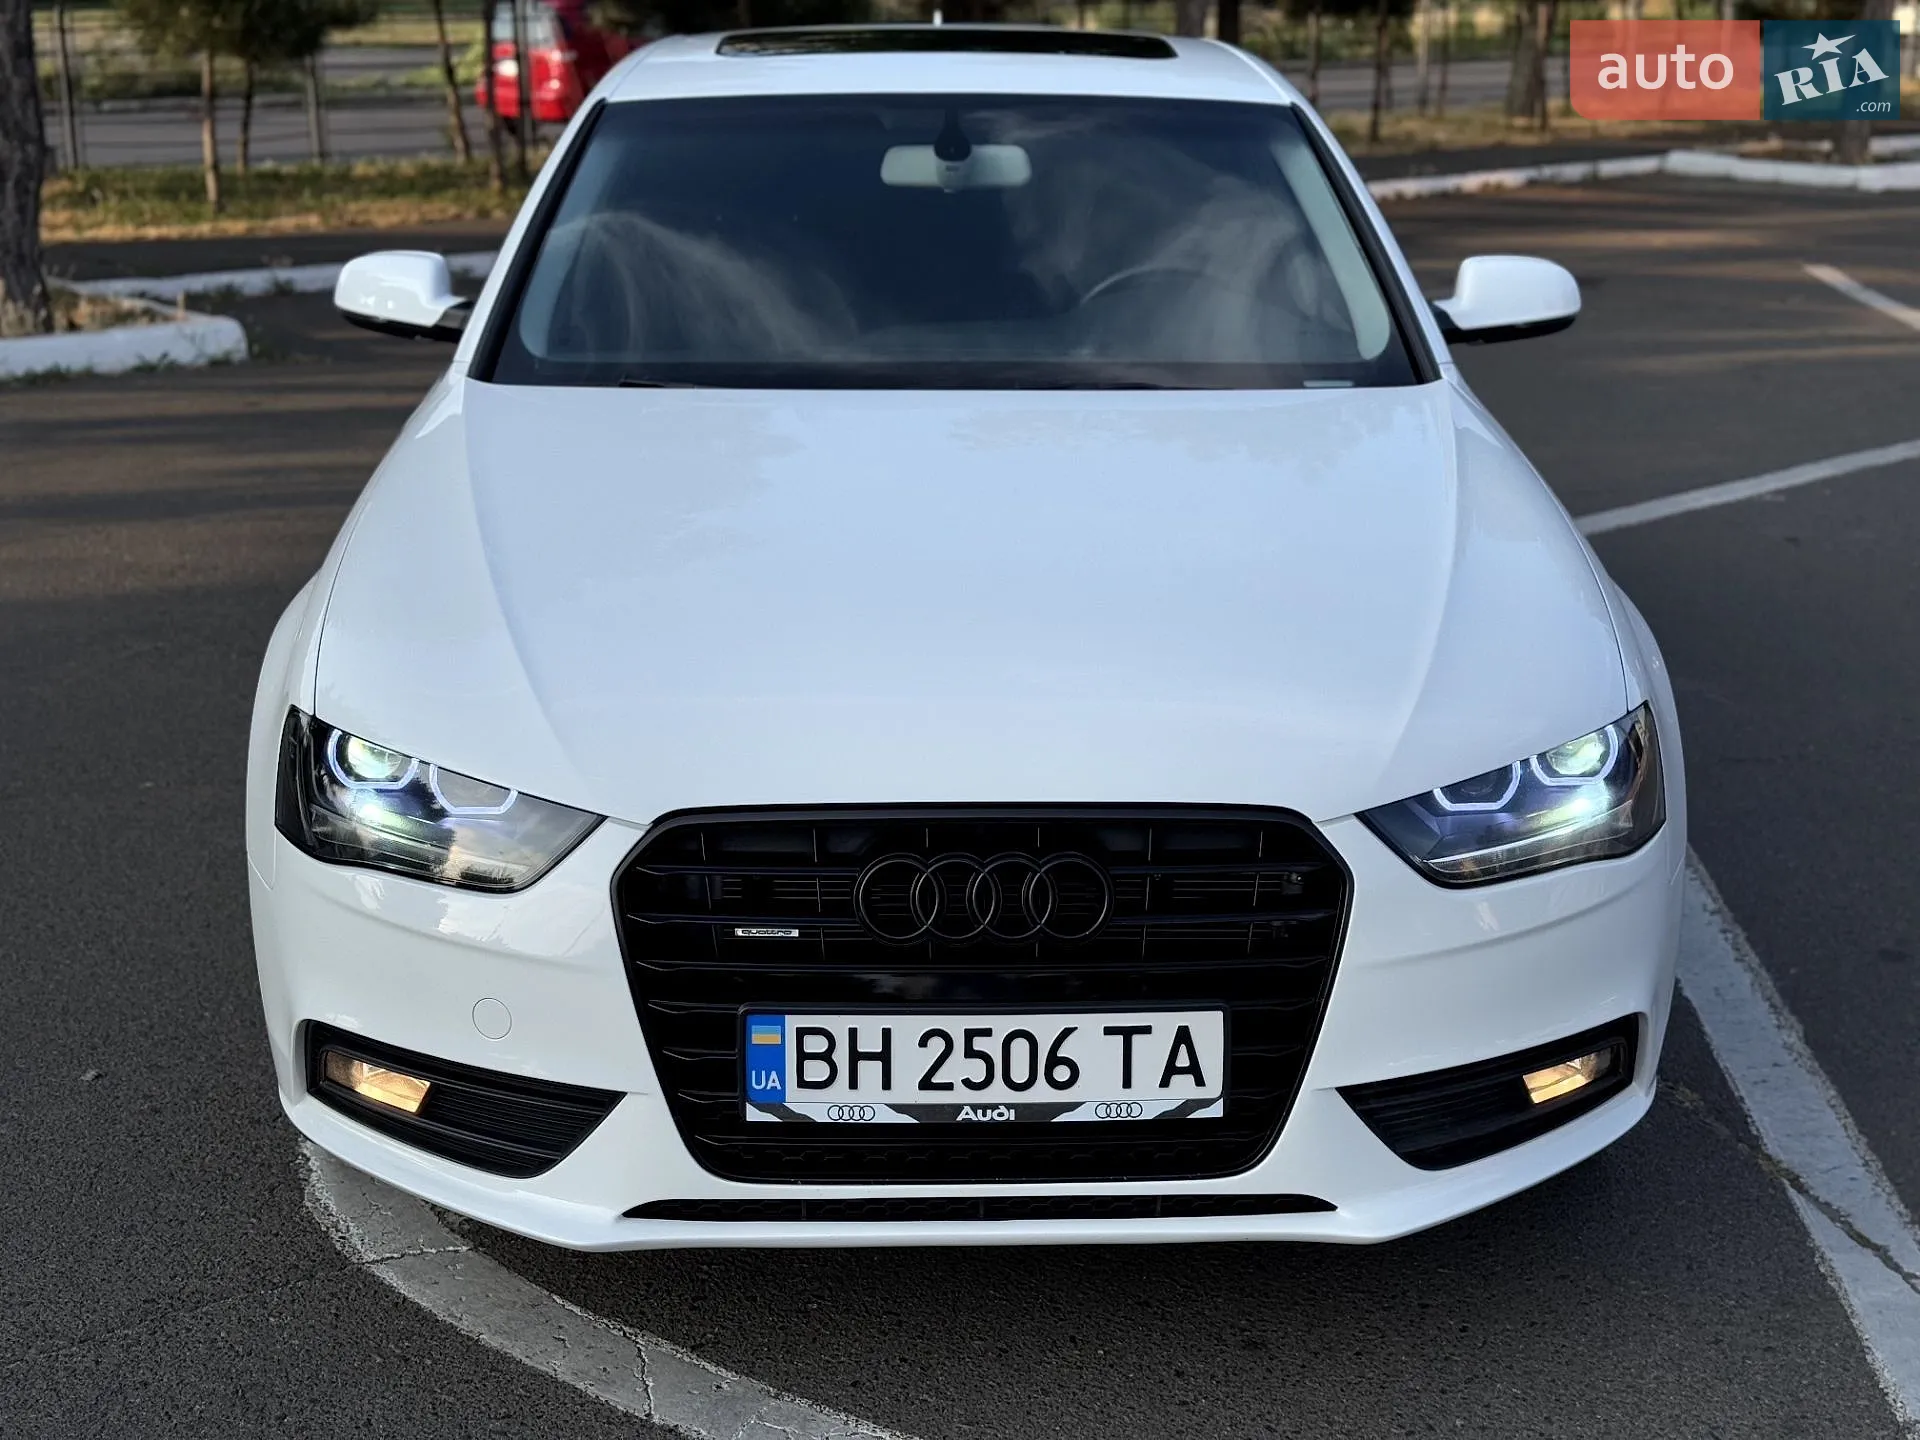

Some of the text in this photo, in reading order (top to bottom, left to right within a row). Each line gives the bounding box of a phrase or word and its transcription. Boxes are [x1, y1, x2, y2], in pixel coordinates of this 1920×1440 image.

[795, 1024, 1207, 1091] BH 2506 TA
[751, 1070, 782, 1091] UA
[956, 1104, 1016, 1121] Audi
